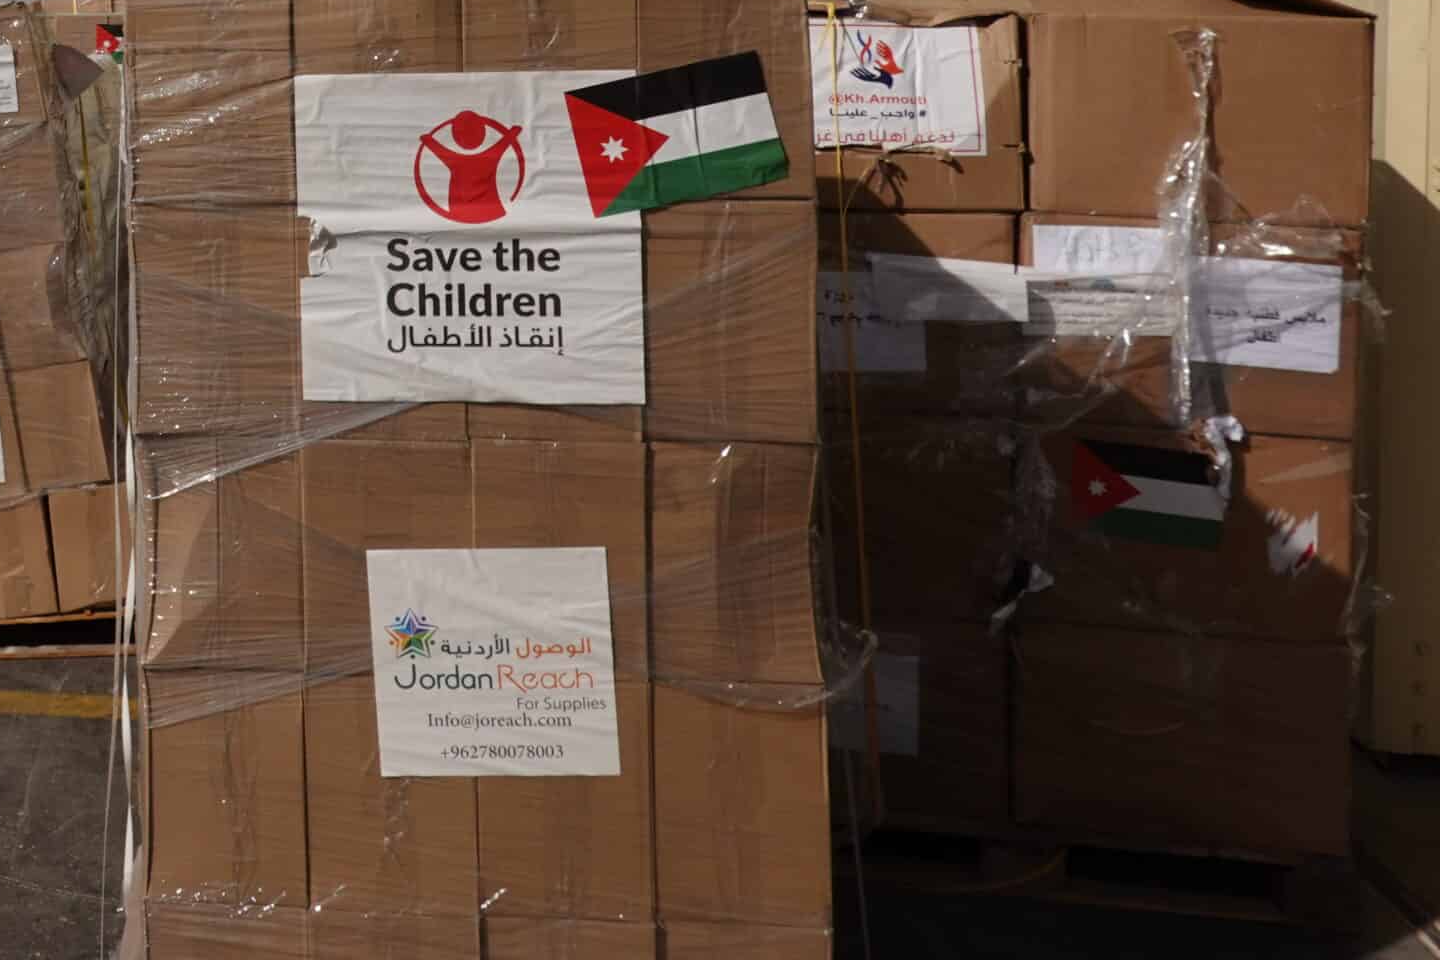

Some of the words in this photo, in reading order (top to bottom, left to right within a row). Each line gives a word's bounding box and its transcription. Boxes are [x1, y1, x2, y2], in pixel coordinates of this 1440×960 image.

[387, 238, 482, 272] Save
[493, 238, 560, 272] the
[387, 282, 561, 317] Children
[387, 323, 492, 353] الأطفال
[499, 326, 564, 356] إنقاذ
[440, 633, 510, 660] الأردنية
[516, 636, 592, 659] الوصول
[516, 697, 539, 711] For
[544, 696, 607, 713] Supplies
[428, 712, 572, 731] Info@joreach.com
[440, 744, 564, 760] +962780078003
